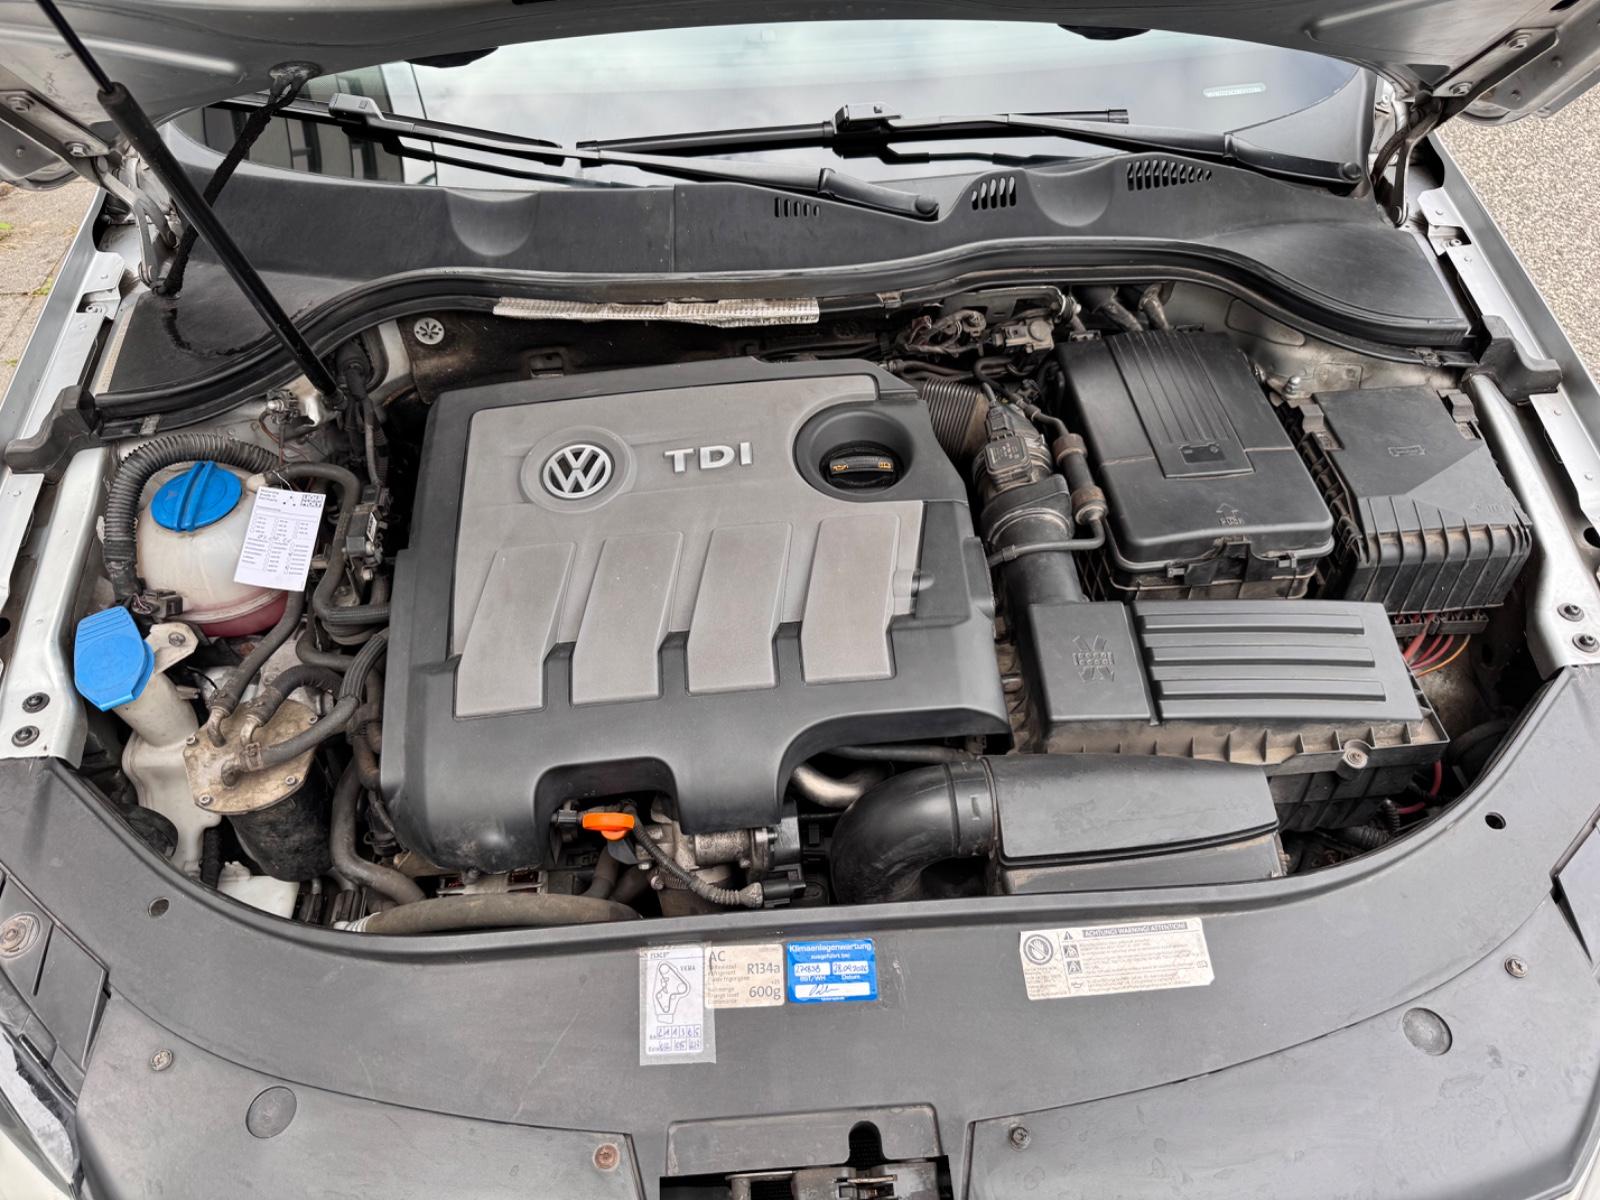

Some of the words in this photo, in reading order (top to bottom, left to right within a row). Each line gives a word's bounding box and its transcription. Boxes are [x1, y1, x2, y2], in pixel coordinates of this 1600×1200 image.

[664, 441, 753, 473] TDI
[709, 951, 726, 961] AC
[747, 962, 781, 975] R134a
[749, 985, 781, 1000] 600g
